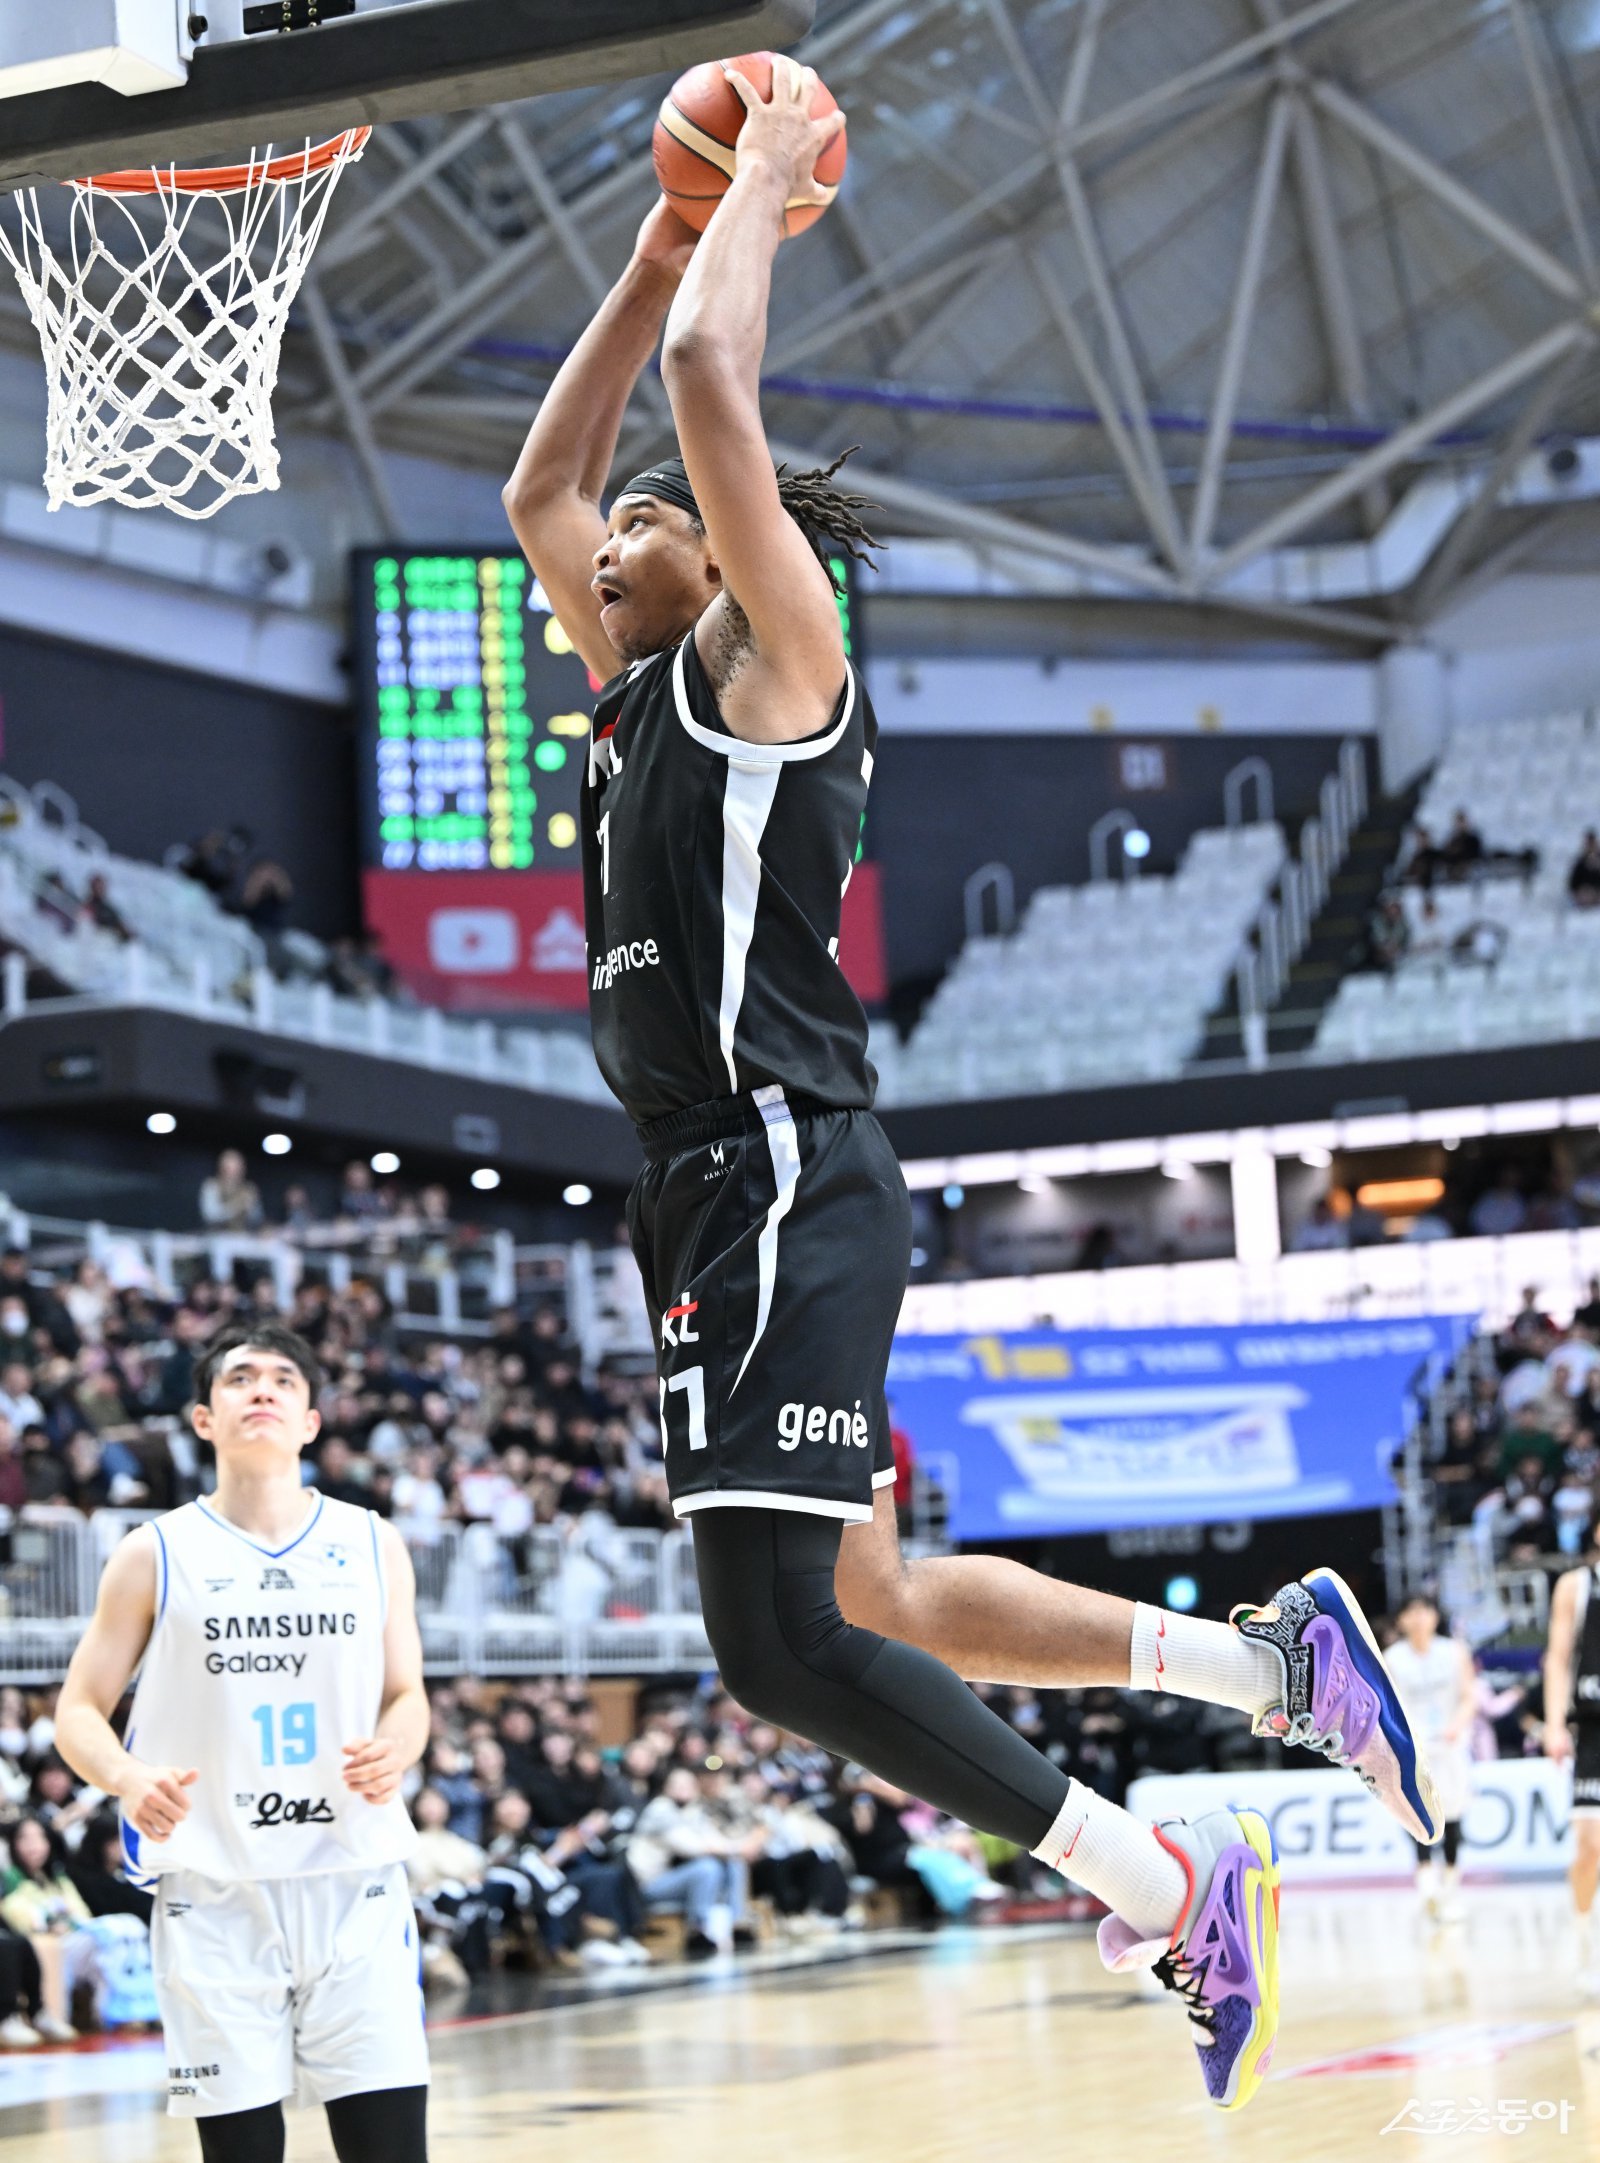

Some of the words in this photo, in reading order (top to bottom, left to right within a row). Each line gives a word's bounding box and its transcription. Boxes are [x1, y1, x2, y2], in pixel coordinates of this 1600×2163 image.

[661, 1291, 701, 1351] kt
[204, 1612, 357, 1642] SAMSUNG
[205, 1651, 308, 1678] Galaxy
[251, 1701, 318, 1767] 19
